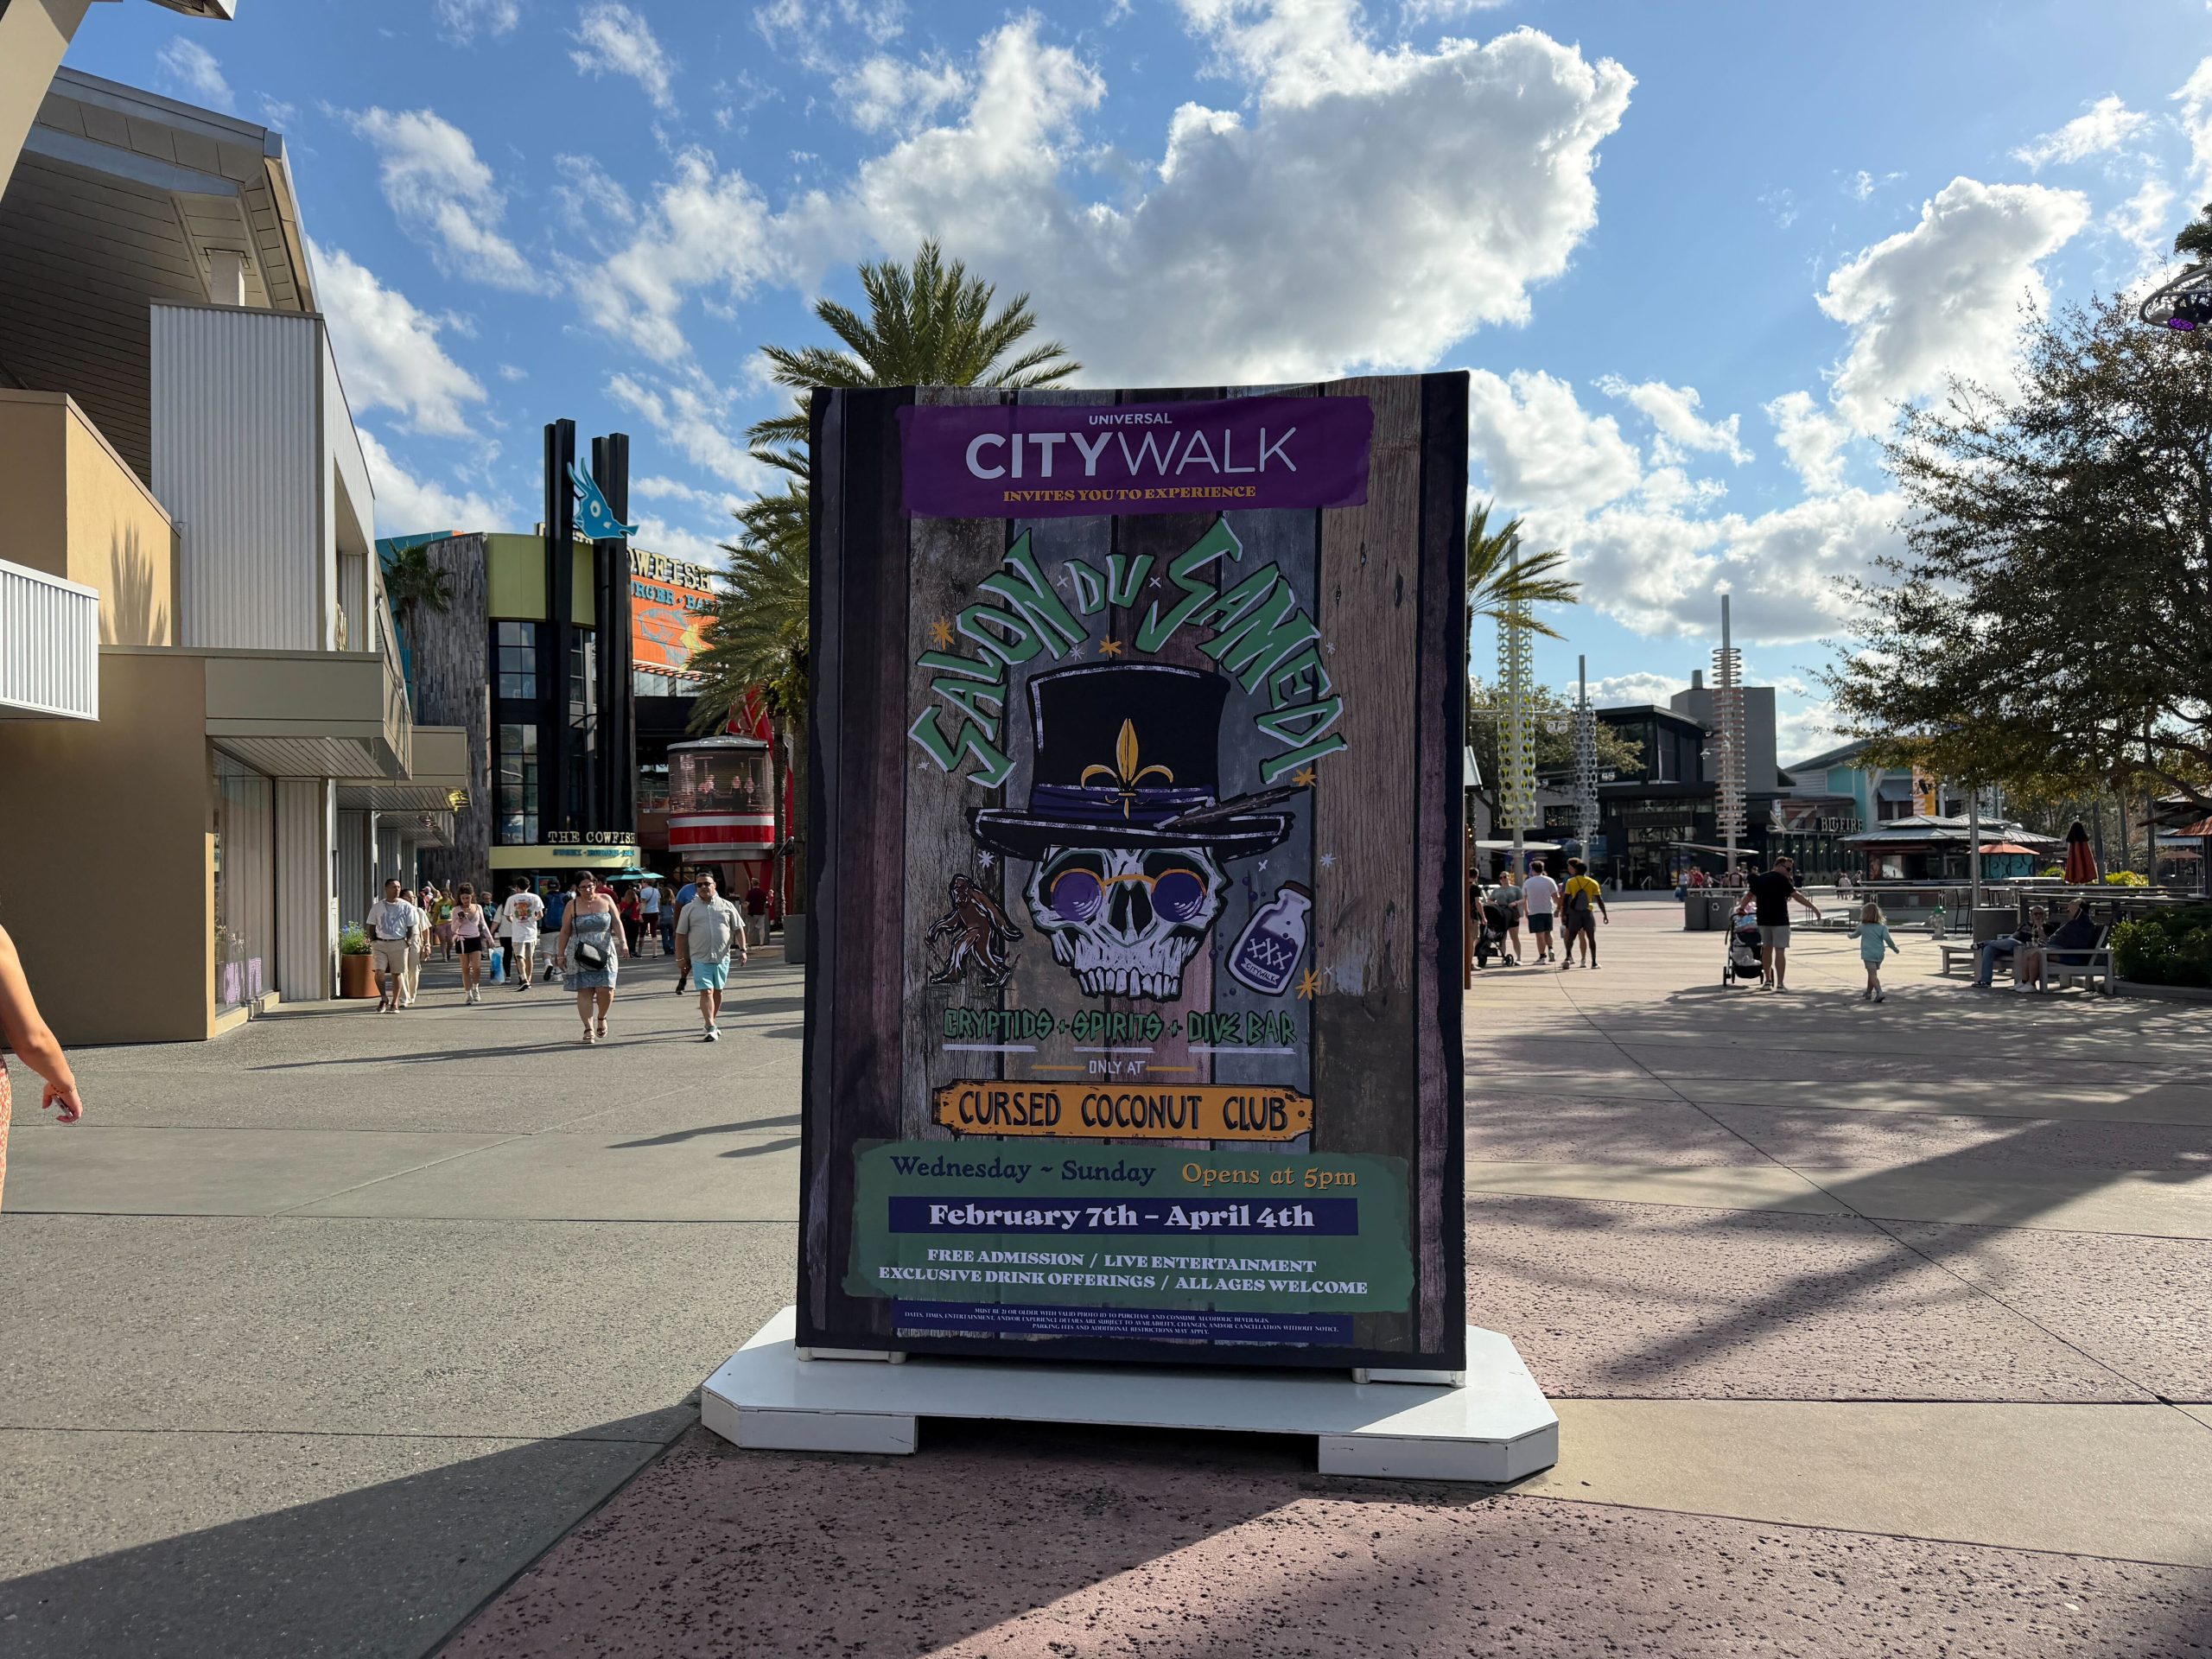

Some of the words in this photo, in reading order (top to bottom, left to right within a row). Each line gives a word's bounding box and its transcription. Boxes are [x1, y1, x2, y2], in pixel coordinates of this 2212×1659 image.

[1089, 412, 1173, 425] UNIVERSAL
[965, 427, 1297, 480] CITYWALK
[1002, 488, 1076, 502] INVITES
[1077, 488, 1116, 501] YOU
[1116, 488, 1141, 500] TO
[1144, 486, 1256, 500] EXPERIENCE
[907, 527, 1090, 789] SALON
[1063, 553, 1155, 616] DU
[1135, 516, 1349, 785] SAMEDI
[548, 830, 581, 843] THE
[586, 830, 636, 844] COWFISH
[1245, 963, 1276, 983] CITYWALK
[943, 1007, 1054, 1040] CRYPTIDS
[1071, 1009, 1164, 1042] SPIRITS
[1187, 1010, 1243, 1044] DIVE
[1247, 1009, 1297, 1046] BAR
[1089, 1059, 1122, 1074] ONLY
[1128, 1060, 1146, 1075] AT
[959, 1090, 1061, 1127] CURSED
[1081, 1093, 1203, 1129] COCONUT
[1223, 1096, 1288, 1131] CLUB
[890, 1155, 1033, 1184] Wednesday
[1061, 1160, 1156, 1186] Sunday
[1182, 1163, 1261, 1187] Opens
[1269, 1166, 1295, 1185] at
[1304, 1167, 1357, 1190] 5pm
[929, 1204, 1081, 1230] February
[1085, 1204, 1139, 1227] 7th
[1164, 1205, 1251, 1230] April
[1256, 1205, 1315, 1228] 4th
[927, 1249, 975, 1262] FREE
[976, 1250, 1085, 1267] ADMISSION
[1104, 1254, 1148, 1268] LIVE
[1151, 1255, 1317, 1274] ENTERTAINMENT
[878, 1267, 982, 1282] EXCLUSIVE
[984, 1270, 1046, 1285] DRINK
[1047, 1272, 1156, 1288] OFFERINGS
[1174, 1276, 1216, 1290] ALL
[1216, 1279, 1266, 1292] AGES
[1268, 1280, 1368, 1294] WELCOME
